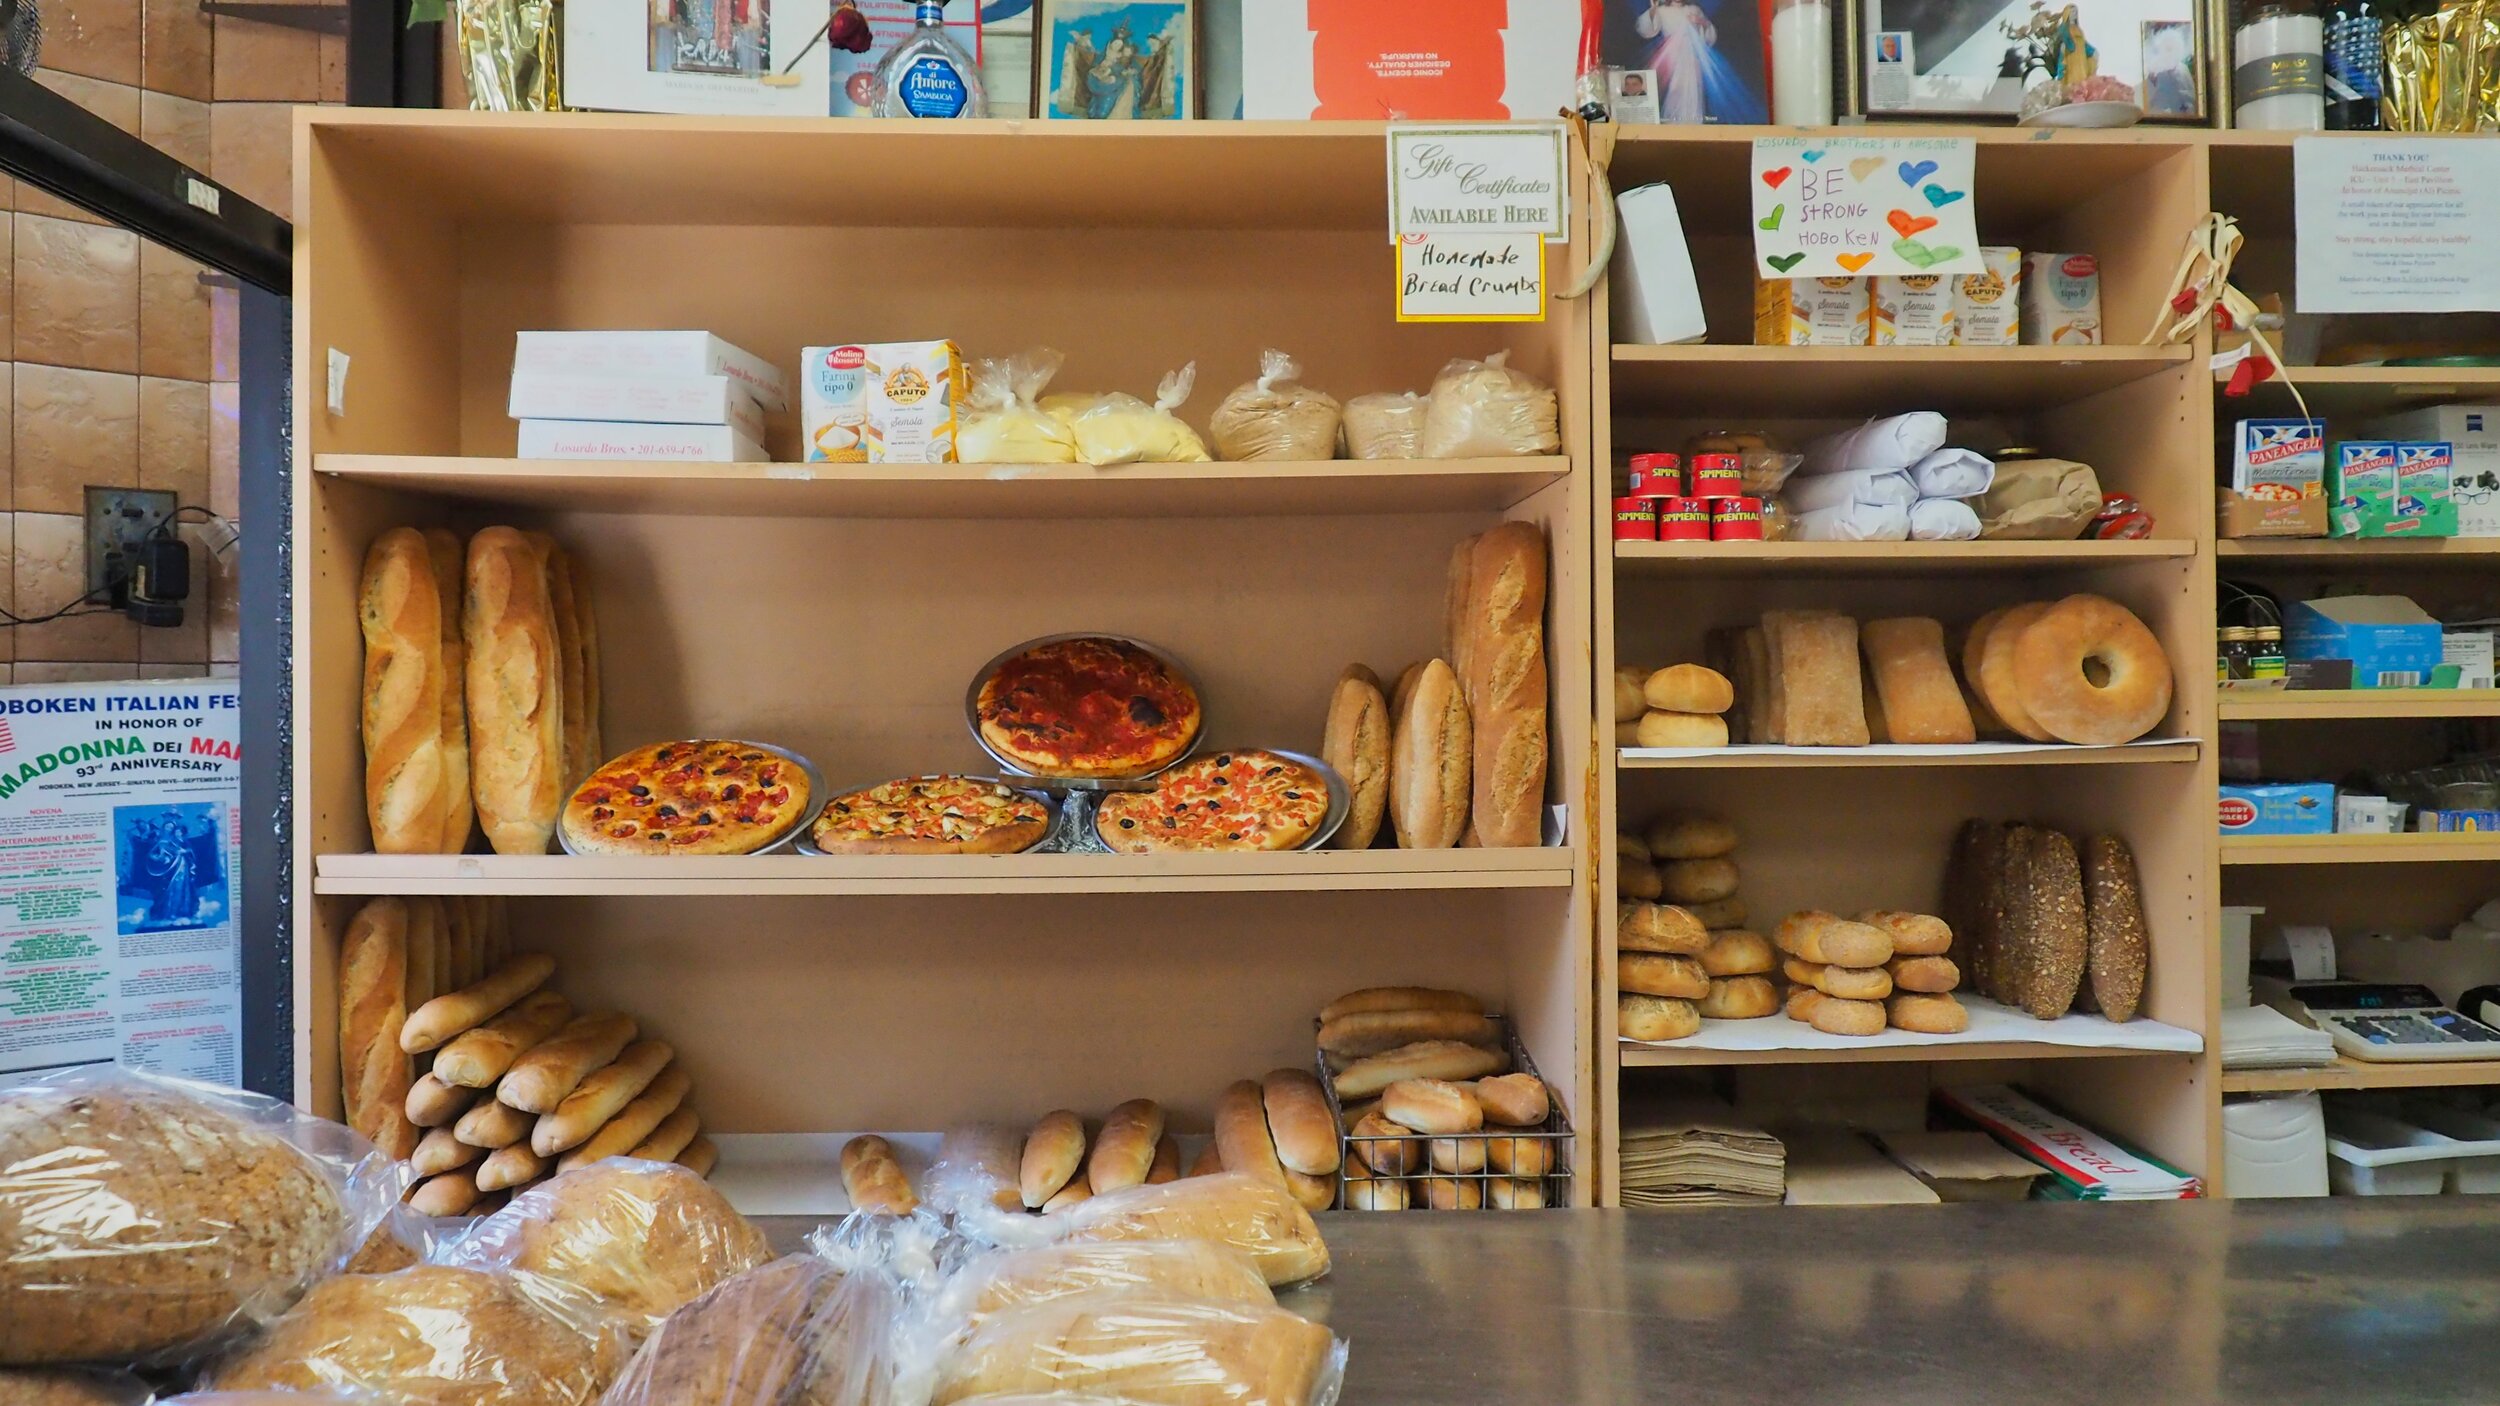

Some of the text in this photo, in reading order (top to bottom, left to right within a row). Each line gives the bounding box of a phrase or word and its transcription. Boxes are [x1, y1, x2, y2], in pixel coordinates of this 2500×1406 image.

[1413, 69, 1443, 77] ICONIC
[910, 72, 957, 91] Amore
[913, 90, 954, 101] SAMBUCA
[1405, 143, 1453, 180] Gift
[1455, 163, 1550, 199] Certificates
[1801, 168, 1844, 201] BE
[1409, 205, 1549, 224] AVAILABLE HERE
[1404, 272, 1463, 296] Bread
[1966, 288, 2003, 297] CAPUTO
[835, 349, 863, 358] Molino
[822, 371, 856, 383] Farina
[824, 382, 845, 394] tipo
[886, 388, 927, 398] CAPUTO
[891, 415, 924, 428] Semola
[554, 442, 597, 454] Losurdo
[106, 696, 199, 712] ITALIAN
[209, 694, 241, 709] FE
[95, 717, 204, 730] IN HONOR OF
[0, 736, 146, 800] MADONNA
[153, 741, 182, 754] DEI
[110, 758, 222, 773] ANNIVERSARY
[2041, 1131, 2140, 1174] Bread
